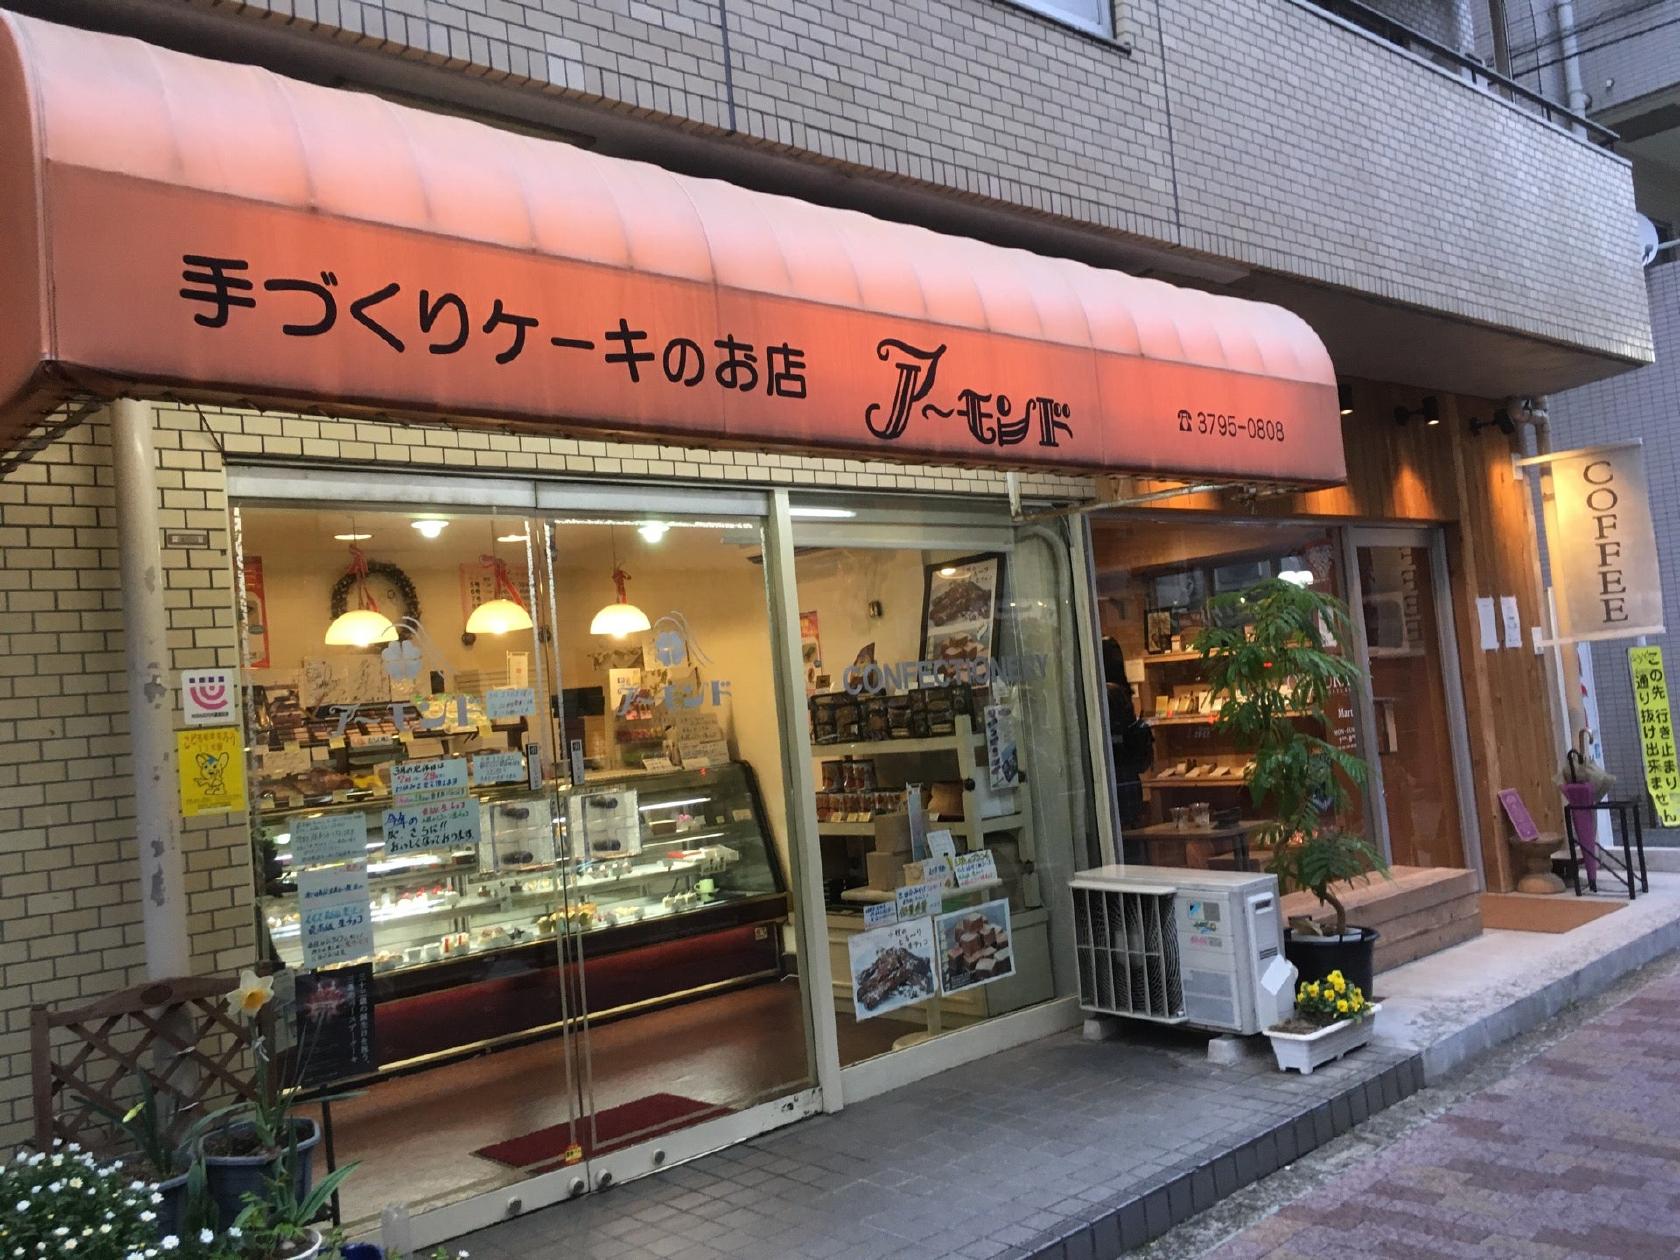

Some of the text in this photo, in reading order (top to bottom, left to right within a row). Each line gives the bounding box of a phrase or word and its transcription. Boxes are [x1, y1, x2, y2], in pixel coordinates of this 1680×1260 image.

[179, 254, 807, 399] 手づくりケーキのお店
[865, 338, 1073, 447] アーモンド
[1197, 412, 1285, 442] 3795-0808
[1583, 460, 1628, 624] COFFEE
[1636, 673, 1677, 822] 通り抜け出来ません
